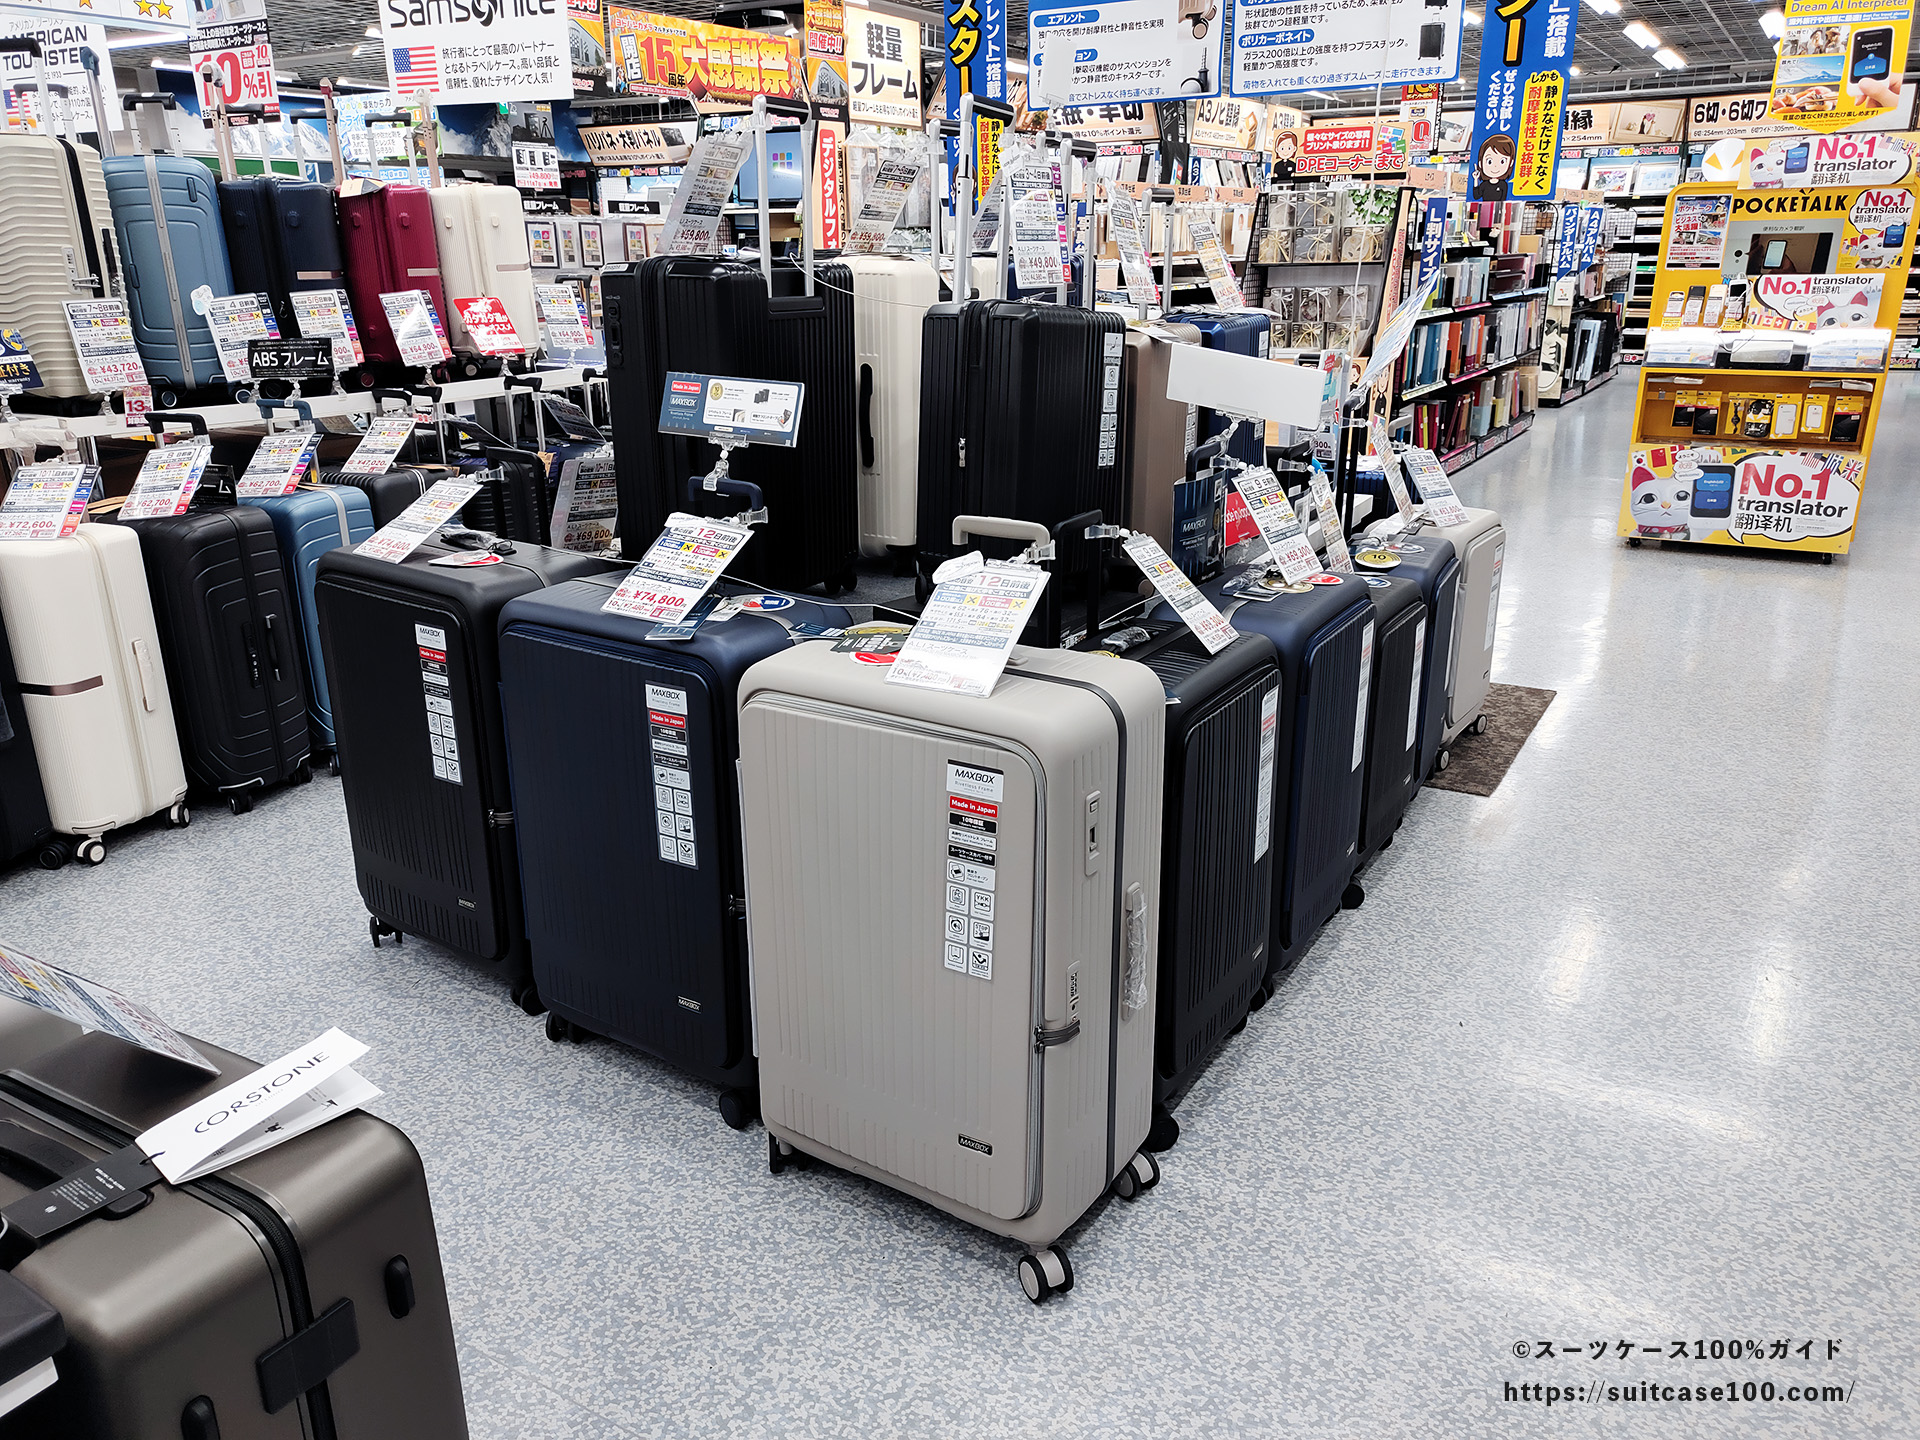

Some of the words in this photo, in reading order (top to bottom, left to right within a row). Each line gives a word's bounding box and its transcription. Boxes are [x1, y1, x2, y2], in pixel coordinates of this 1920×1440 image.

[1791, 2, 1828, 12] Dream
[1831, 0, 1843, 10] AI
[1047, 13, 1086, 25] エアレント
[4, 25, 88, 46] RICAN
[866, 21, 903, 63] 軽量
[1241, 31, 1311, 48] ポリカーボネイト
[2, 47, 80, 71] TOUISTE
[442, 42, 555, 59] 旅行者にとって最高のパートナー
[444, 56, 560, 74] となるトラベルケース。高い品質と
[621, 37, 643, 81] 開店
[681, 37, 791, 95] 大感謝祭
[1243, 58, 1319, 72] 軽量かつ高強度です。
[851, 61, 919, 101] フレーム
[1531, 71, 1559, 84] しかも
[1499, 69, 1518, 132] ぜひお試し
[1306, 130, 1371, 142] 様々なサイズの写真
[1534, 85, 1558, 190] 静かなだけでなく
[1814, 136, 1877, 161] No.1
[1296, 153, 1405, 173] DPEコーナーまで
[1813, 157, 1897, 173] translator
[1732, 194, 1849, 215] POCKETALK
[1863, 191, 1908, 208] No.1
[1855, 204, 1911, 215] translator
[1762, 277, 1811, 295] No.1
[1812, 275, 1875, 286] translator
[252, 351, 279, 367] ABS
[280, 350, 330, 366] フレーム
[1740, 462, 1832, 500] No.1
[1737, 495, 1848, 520] translator
[1734, 512, 1793, 534] 翻译机
[697, 527, 738, 544] 12日前後
[979, 574, 1031, 590] 12日前後
[651, 688, 681, 700] MAXBOX
[669, 716, 684, 727] Japan
[954, 768, 996, 785] MAXBOX
[951, 799, 969, 809] Made
[976, 805, 996, 815] Japan
[976, 893, 989, 902] YKK
[194, 1050, 331, 1135] CORSTONE
[959, 1137, 990, 1154] MAXBOX
